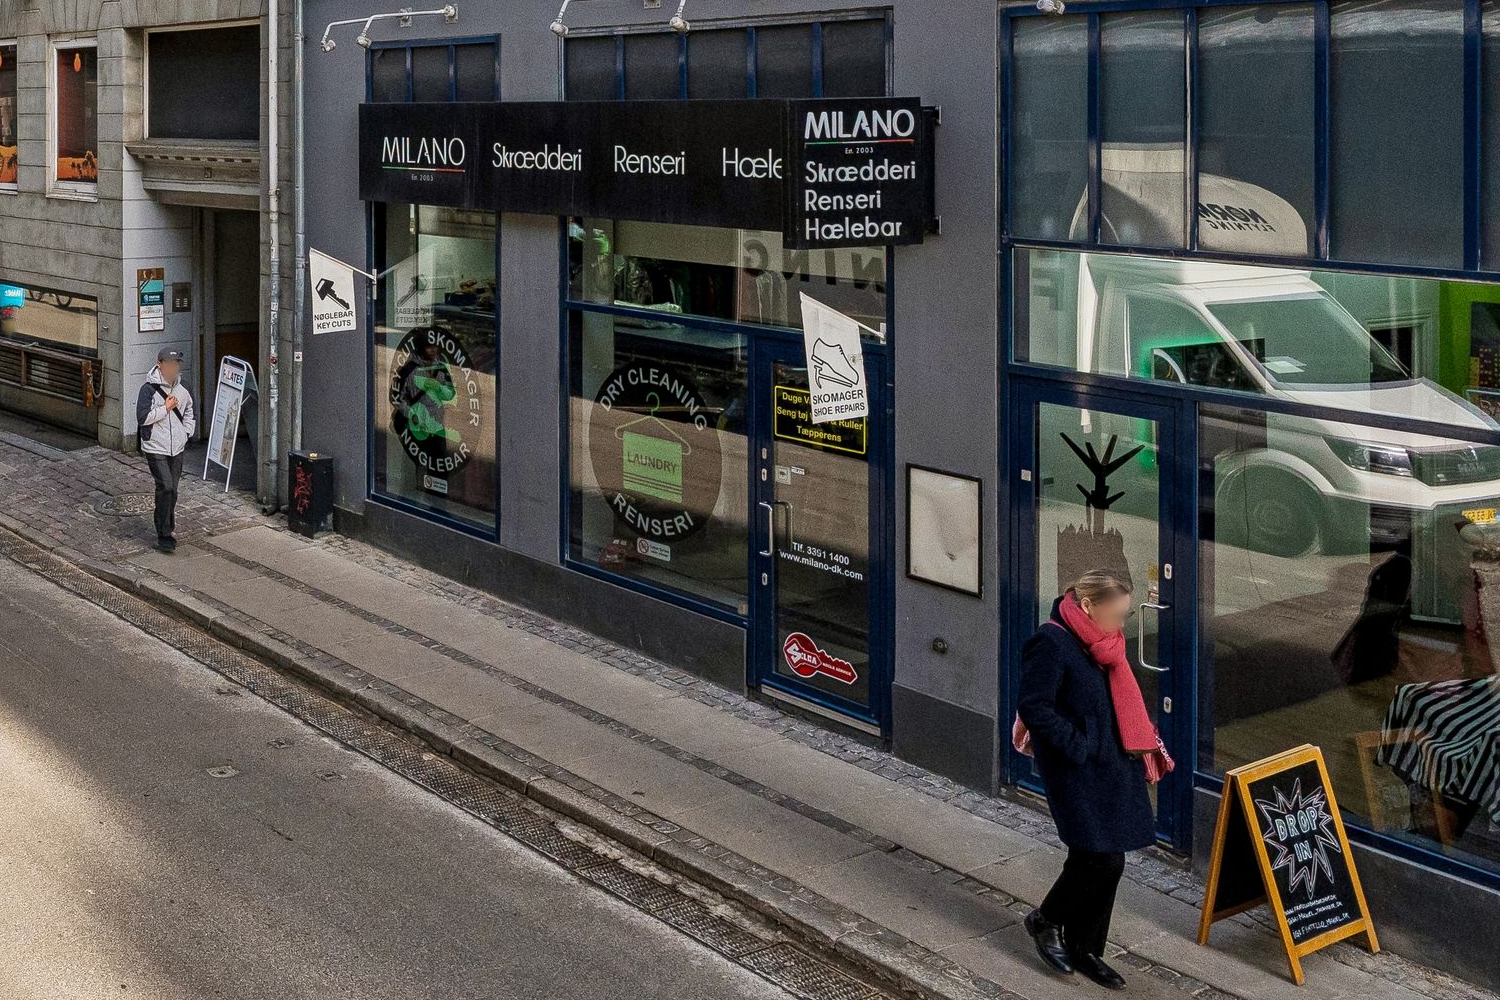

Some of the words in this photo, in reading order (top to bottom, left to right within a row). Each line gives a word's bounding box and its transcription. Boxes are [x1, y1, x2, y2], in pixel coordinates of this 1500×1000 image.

[804, 109, 915, 140] MILANO
[382, 136, 466, 166] MILANO
[492, 142, 582, 172] Skrædderi
[614, 145, 685, 175] Renseri
[855, 146, 874, 154] 2003
[420, 174, 434, 182] 2003
[805, 158, 916, 183] Skrædderi
[805, 190, 881, 212] Renseri
[806, 216, 902, 240] Hælebar
[314, 310, 354, 322] NØGLEBAR
[317, 321, 331, 330] KEY
[332, 320, 352, 328] CUTS
[392, 368, 402, 406] KEY
[398, 336, 416, 367] CUT
[428, 330, 480, 427] SKOMAGER
[600, 375, 625, 412] DRY
[628, 368, 708, 432] CLEANING
[782, 392, 802, 404] Duge
[812, 389, 864, 405] SKOMAGER
[776, 406, 796, 418] Seng
[798, 410, 808, 420] tøj
[838, 420, 863, 430] Ruller
[814, 406, 833, 417] SHOE
[834, 402, 865, 414] REPAIRS
[796, 426, 842, 442] Tæpperens
[401, 428, 470, 472] NØGLEBAR
[627, 452, 678, 474] LAUNDRY
[614, 492, 694, 537] RENSERI
[779, 549, 864, 582] www.milano-dk.com
[792, 541, 804, 553] Tlf.
[806, 546, 826, 560] 3391
[828, 552, 850, 566] 1400
[1274, 806, 1318, 842] DROP
[1294, 840, 1312, 862] IN
